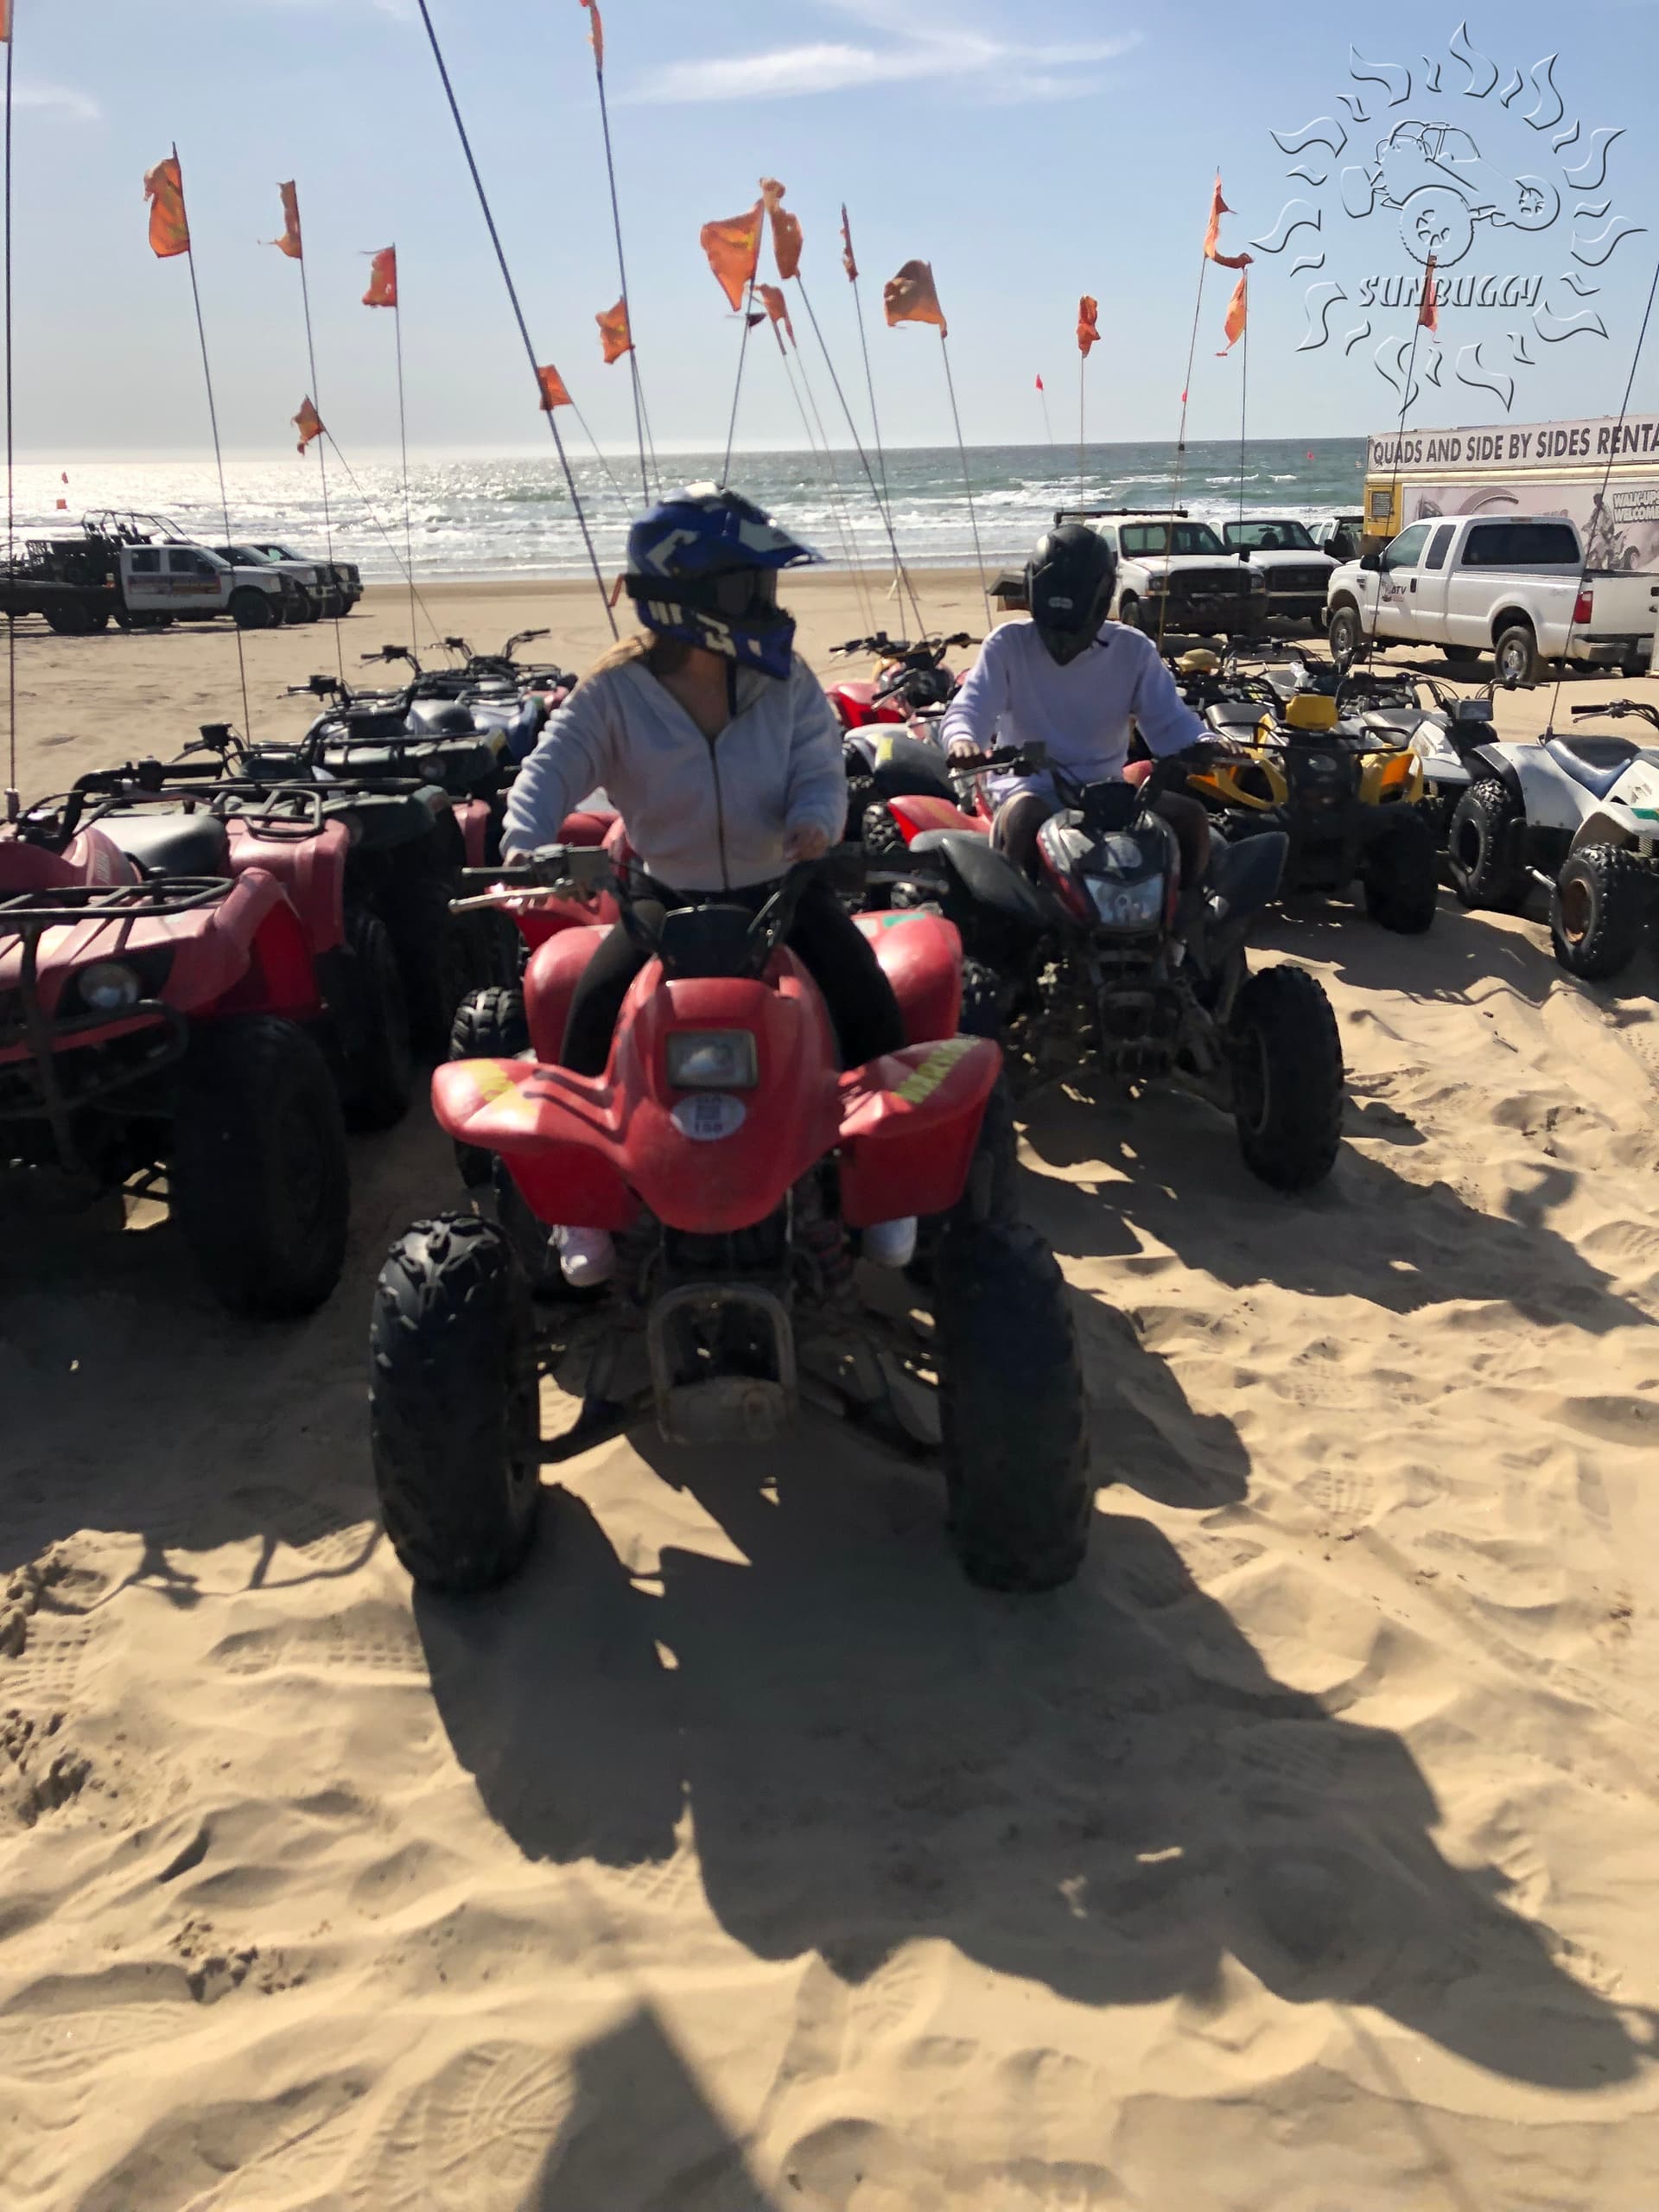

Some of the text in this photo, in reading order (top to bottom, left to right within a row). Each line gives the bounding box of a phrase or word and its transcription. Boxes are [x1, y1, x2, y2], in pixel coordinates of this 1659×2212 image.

[1374, 440, 1422, 465] QUADS
[1426, 438, 1462, 462] AND
[1466, 435, 1503, 461] SIDE
[1509, 433, 1532, 460] BY
[1535, 428, 1591, 458] SIDES
